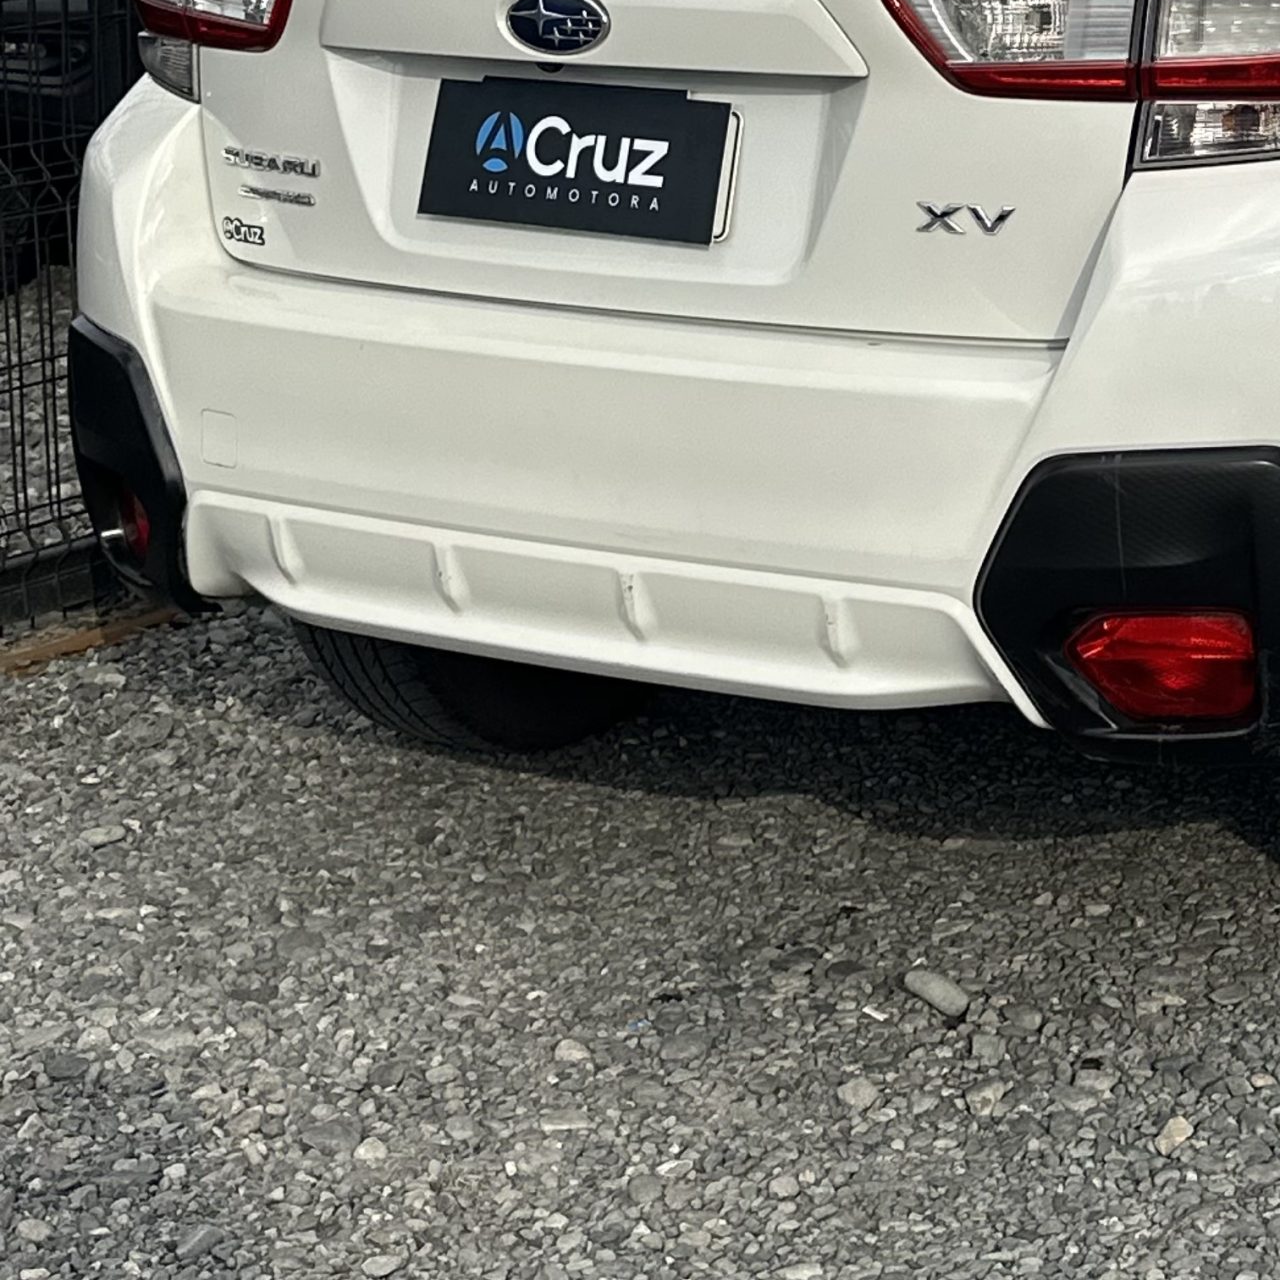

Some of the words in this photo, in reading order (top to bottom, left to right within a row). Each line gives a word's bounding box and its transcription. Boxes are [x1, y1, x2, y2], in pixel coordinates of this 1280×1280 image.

[222, 146, 321, 178] SUBARU
[469, 178, 660, 211] AUTOMOTORA
[915, 200, 1017, 236] XV
